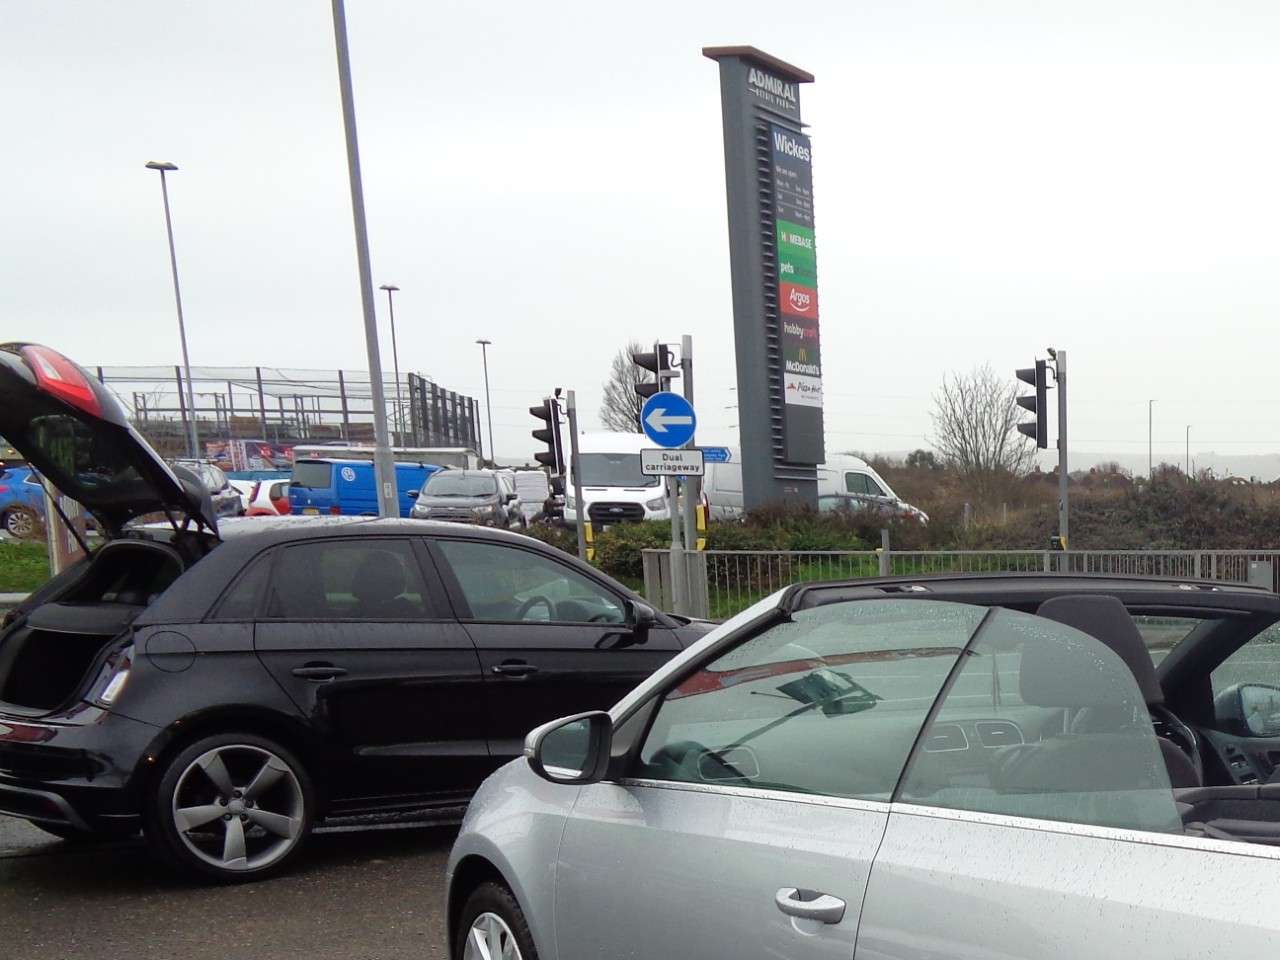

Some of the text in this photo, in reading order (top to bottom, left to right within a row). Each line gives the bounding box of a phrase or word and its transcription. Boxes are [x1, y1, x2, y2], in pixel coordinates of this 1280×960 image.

[748, 68, 796, 102] ADMIRAL
[774, 131, 810, 162] Wickes
[789, 287, 811, 306] Argos
[662, 453, 683, 462] Dual
[645, 463, 700, 474] carriageway
